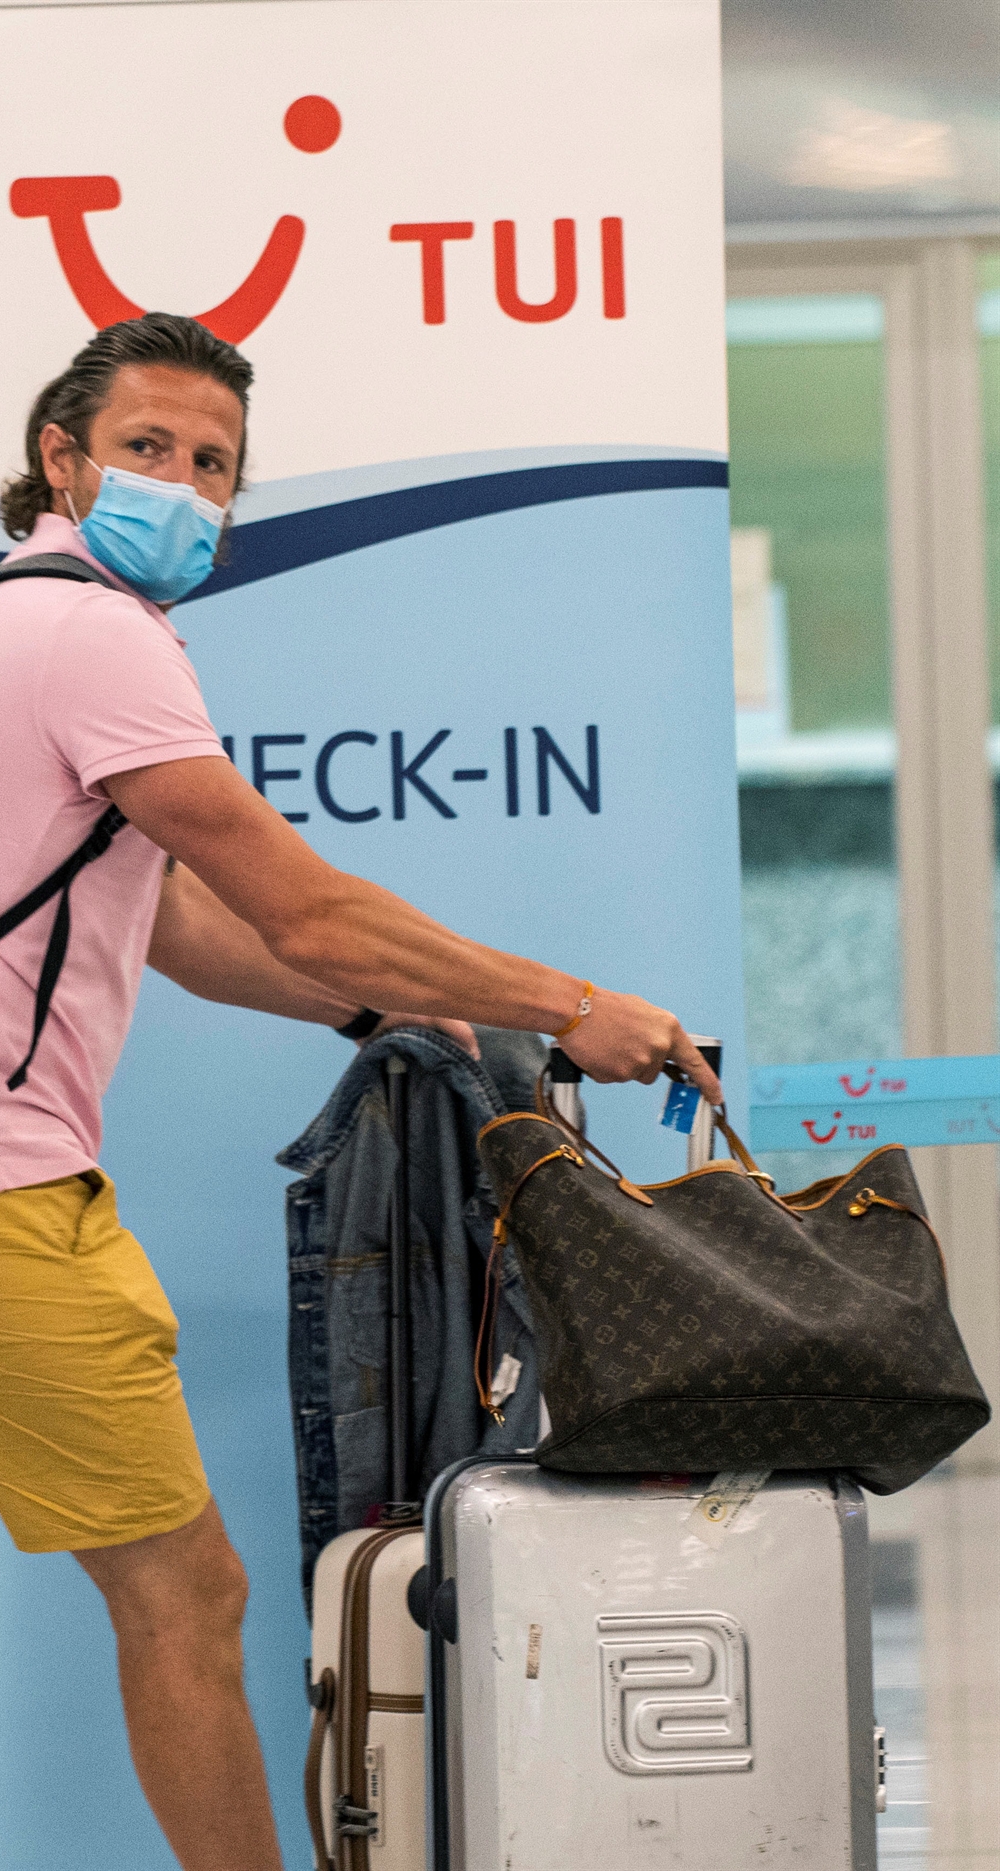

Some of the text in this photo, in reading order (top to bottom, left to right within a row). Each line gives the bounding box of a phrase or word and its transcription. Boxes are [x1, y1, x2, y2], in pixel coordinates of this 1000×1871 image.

[389, 216, 627, 326] TUI
[222, 724, 601, 824] ECK-IN
[847, 1124, 878, 1141] TUI
